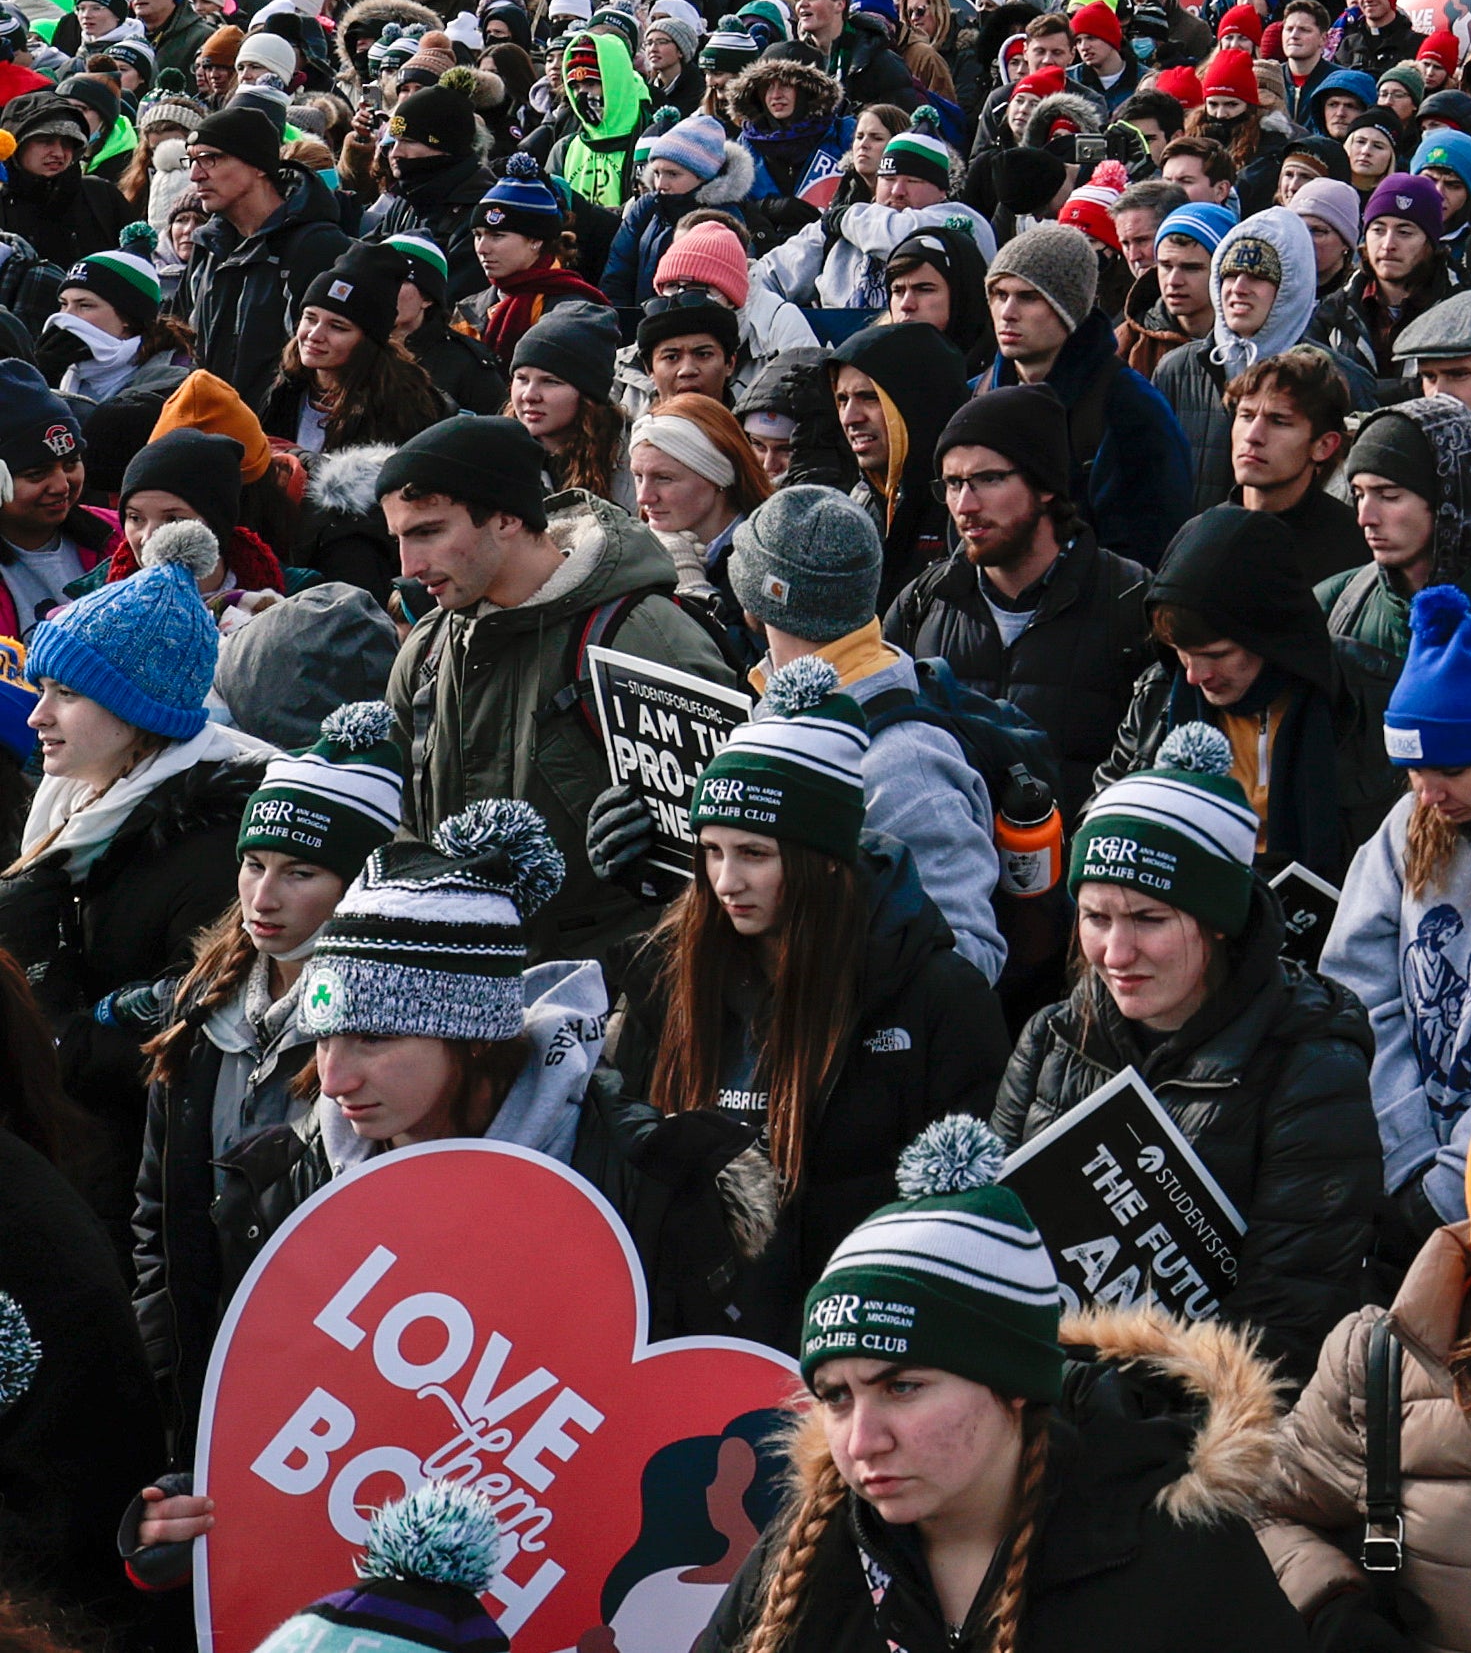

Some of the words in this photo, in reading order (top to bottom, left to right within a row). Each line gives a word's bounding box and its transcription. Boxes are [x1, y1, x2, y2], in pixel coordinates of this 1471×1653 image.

[627, 679, 724, 726] STUDENTSFORLIFE.ORG
[614, 695, 626, 728] I
[638, 704, 685, 748] AM
[690, 713, 728, 758] TH
[746, 785, 760, 794] ANN
[762, 788, 783, 798] ARBOR
[748, 794, 782, 806] MICHIGAN
[295, 808, 310, 816] ANN
[311, 812, 331, 824] ARBOR
[698, 804, 742, 818] PRO-LIFE
[744, 808, 777, 824] CLUB
[297, 817, 328, 832] MICHIGAN
[246, 825, 290, 838] PRO-LIFE
[291, 831, 323, 849] CLUB
[1139, 846, 1155, 857] ANN
[1156, 849, 1178, 864] ARBOR
[1142, 855, 1175, 873] MICHIGAN
[1083, 864, 1135, 880] PRO-LIFE
[1138, 872, 1172, 892] CLUB
[1285, 909, 1318, 935] IS
[863, 1036, 894, 1048] NORTH
[876, 1030, 894, 1039] THE
[871, 1044, 895, 1054] FACE
[1081, 1143, 1150, 1226] THE
[862, 1299, 884, 1311] ANN
[885, 1302, 916, 1316] ARBOR
[866, 1312, 913, 1328] MICHIGAN
[806, 1332, 857, 1355] PRO-LIFE
[861, 1333, 908, 1354] CLUB
[314, 1243, 606, 1494] LOVE
[250, 1386, 567, 1639] BOH
